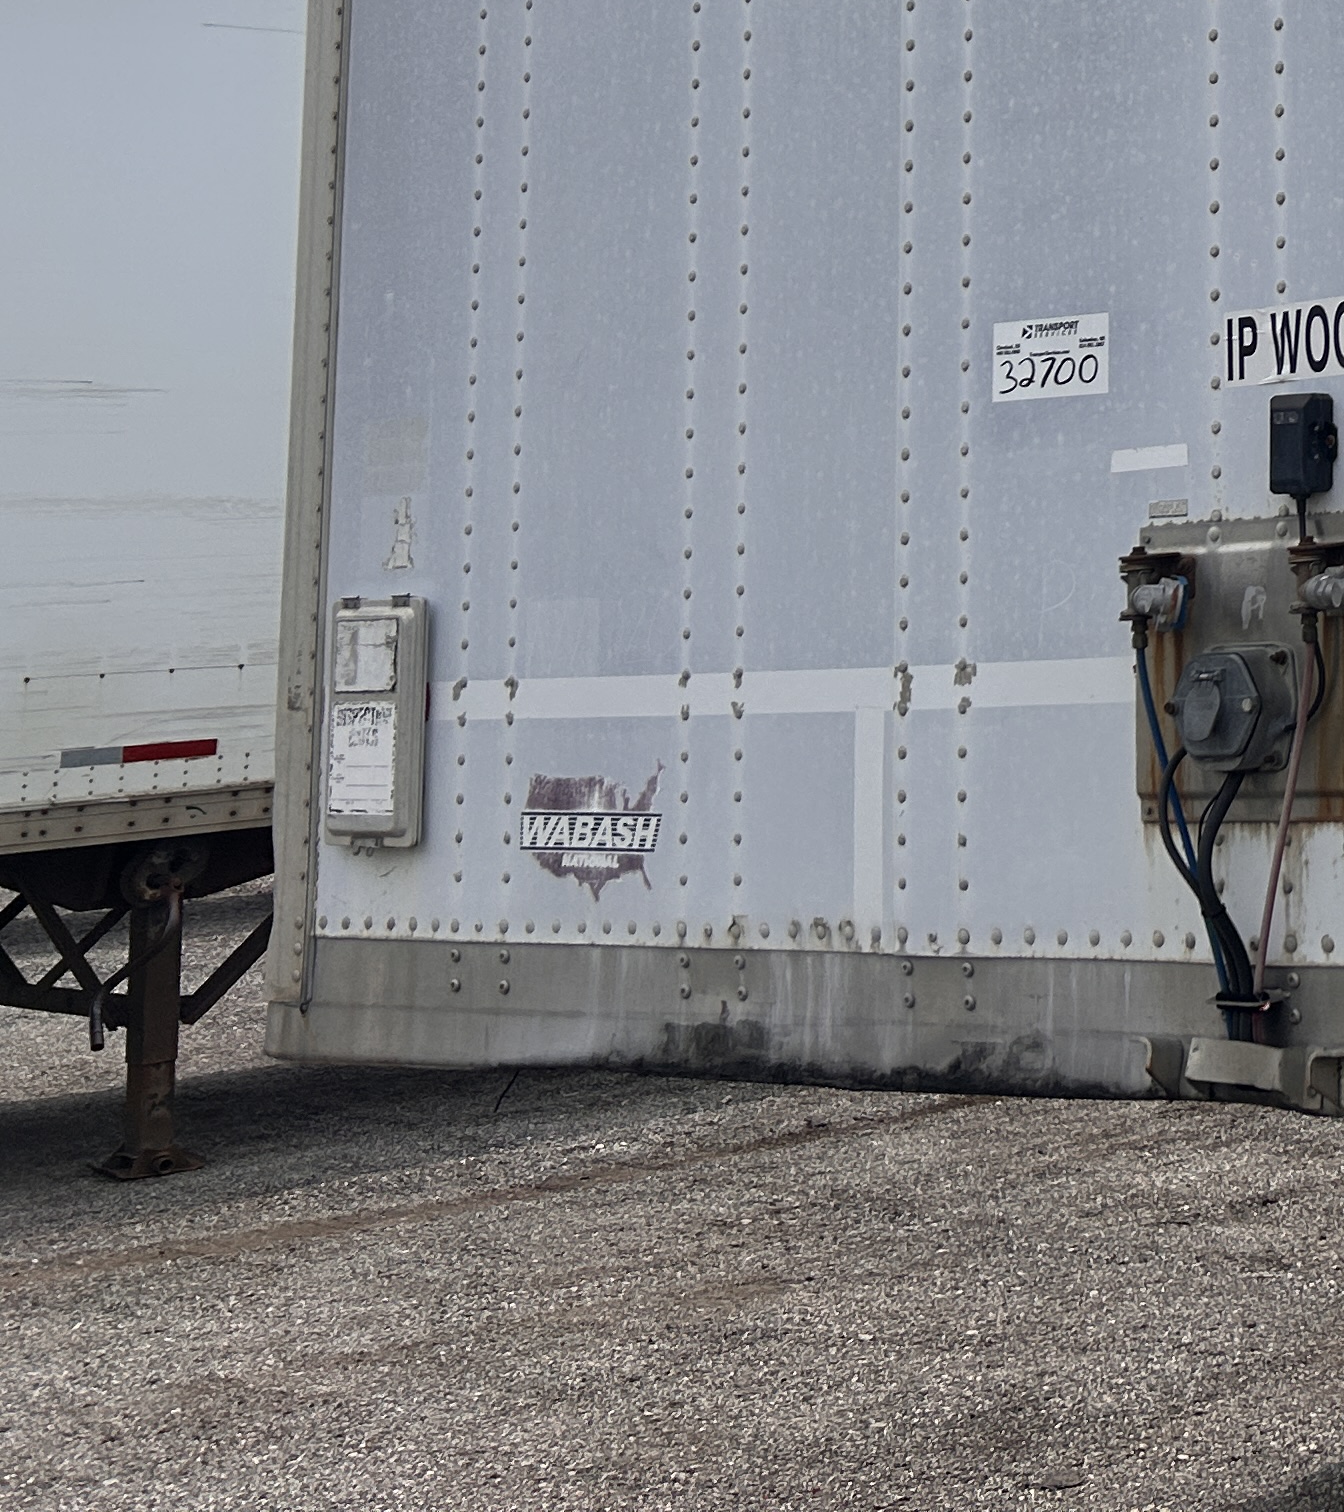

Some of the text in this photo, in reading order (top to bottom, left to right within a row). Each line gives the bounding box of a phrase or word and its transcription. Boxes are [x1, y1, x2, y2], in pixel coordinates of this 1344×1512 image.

[1034, 320, 1080, 332] TRANSPORT
[1226, 316, 1258, 381] IP
[999, 354, 1098, 394] 32700
[522, 815, 658, 848] WABASH
[561, 853, 620, 868] NATIONAL
